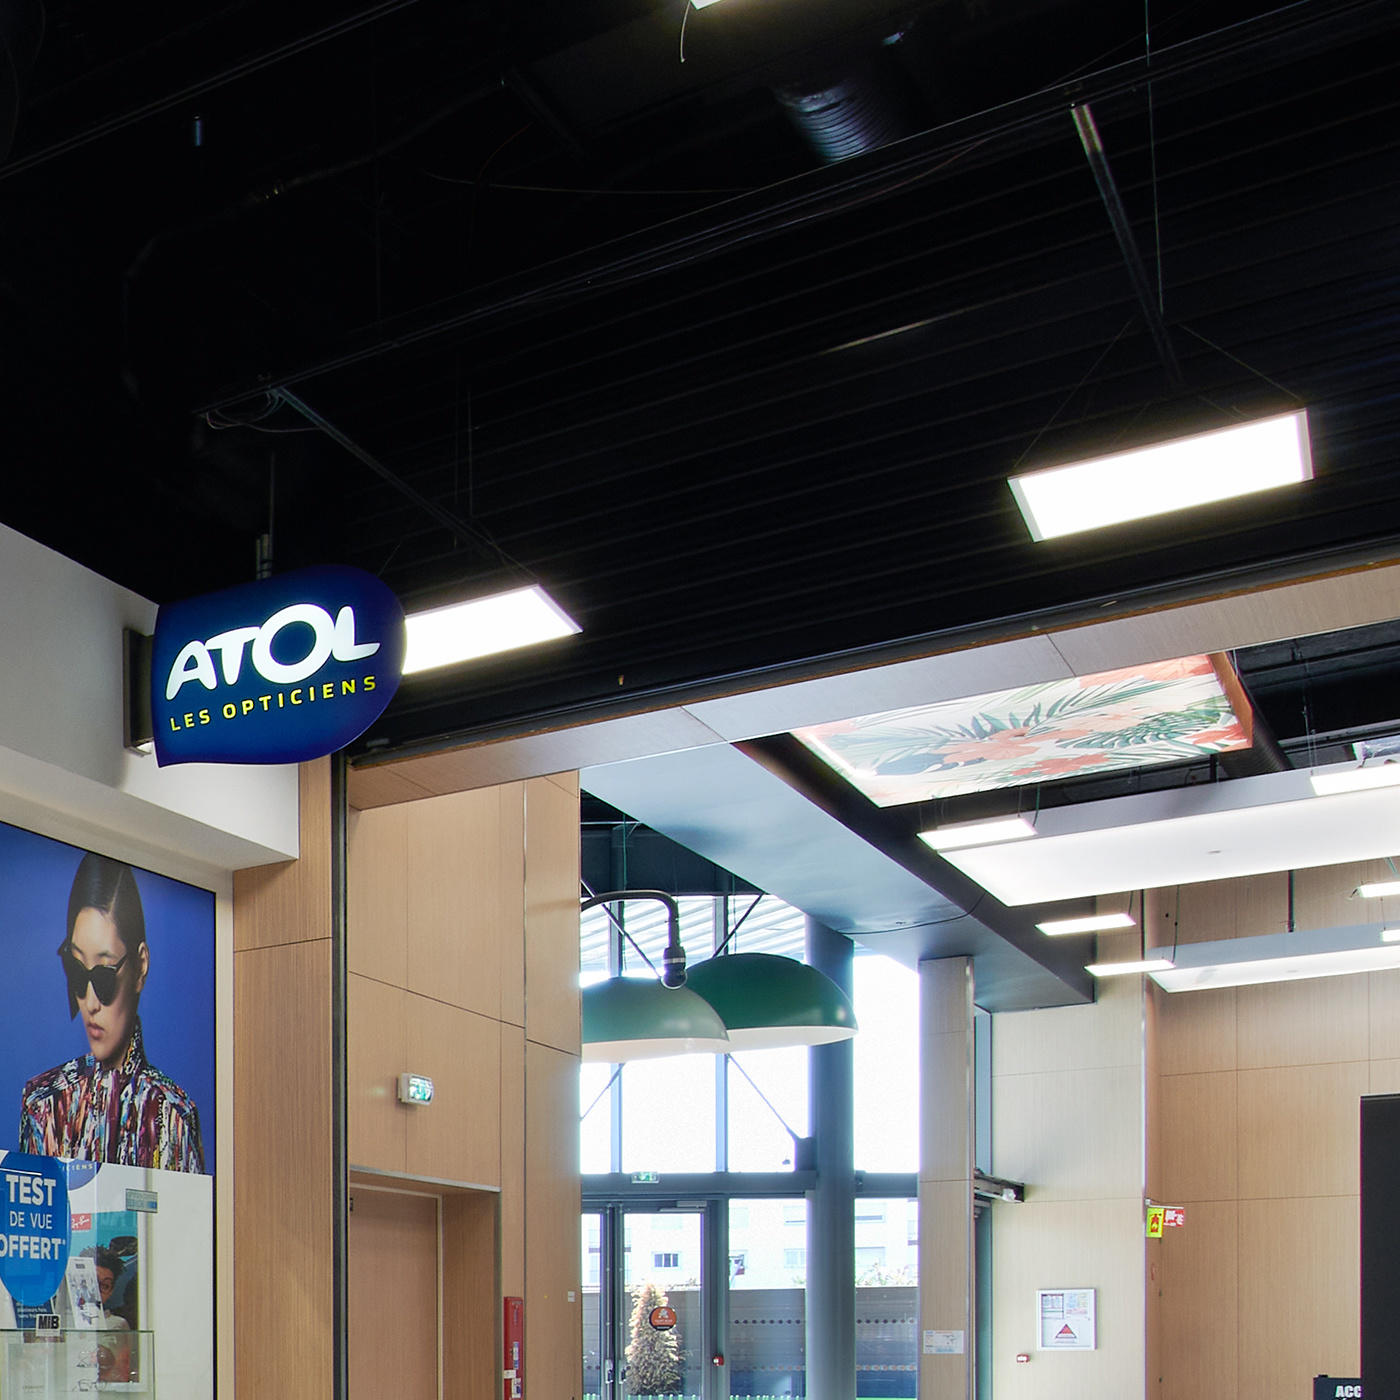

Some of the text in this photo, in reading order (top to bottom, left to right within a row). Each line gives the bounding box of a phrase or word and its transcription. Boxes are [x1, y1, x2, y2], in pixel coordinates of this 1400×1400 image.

[166, 603, 380, 700] ATOL
[170, 676, 376, 732] LES OPTICIENS
[6, 1174, 56, 1206] TEST
[9, 1210, 52, 1230] DE VUE
[1335, 1385, 1362, 1398] ACC
